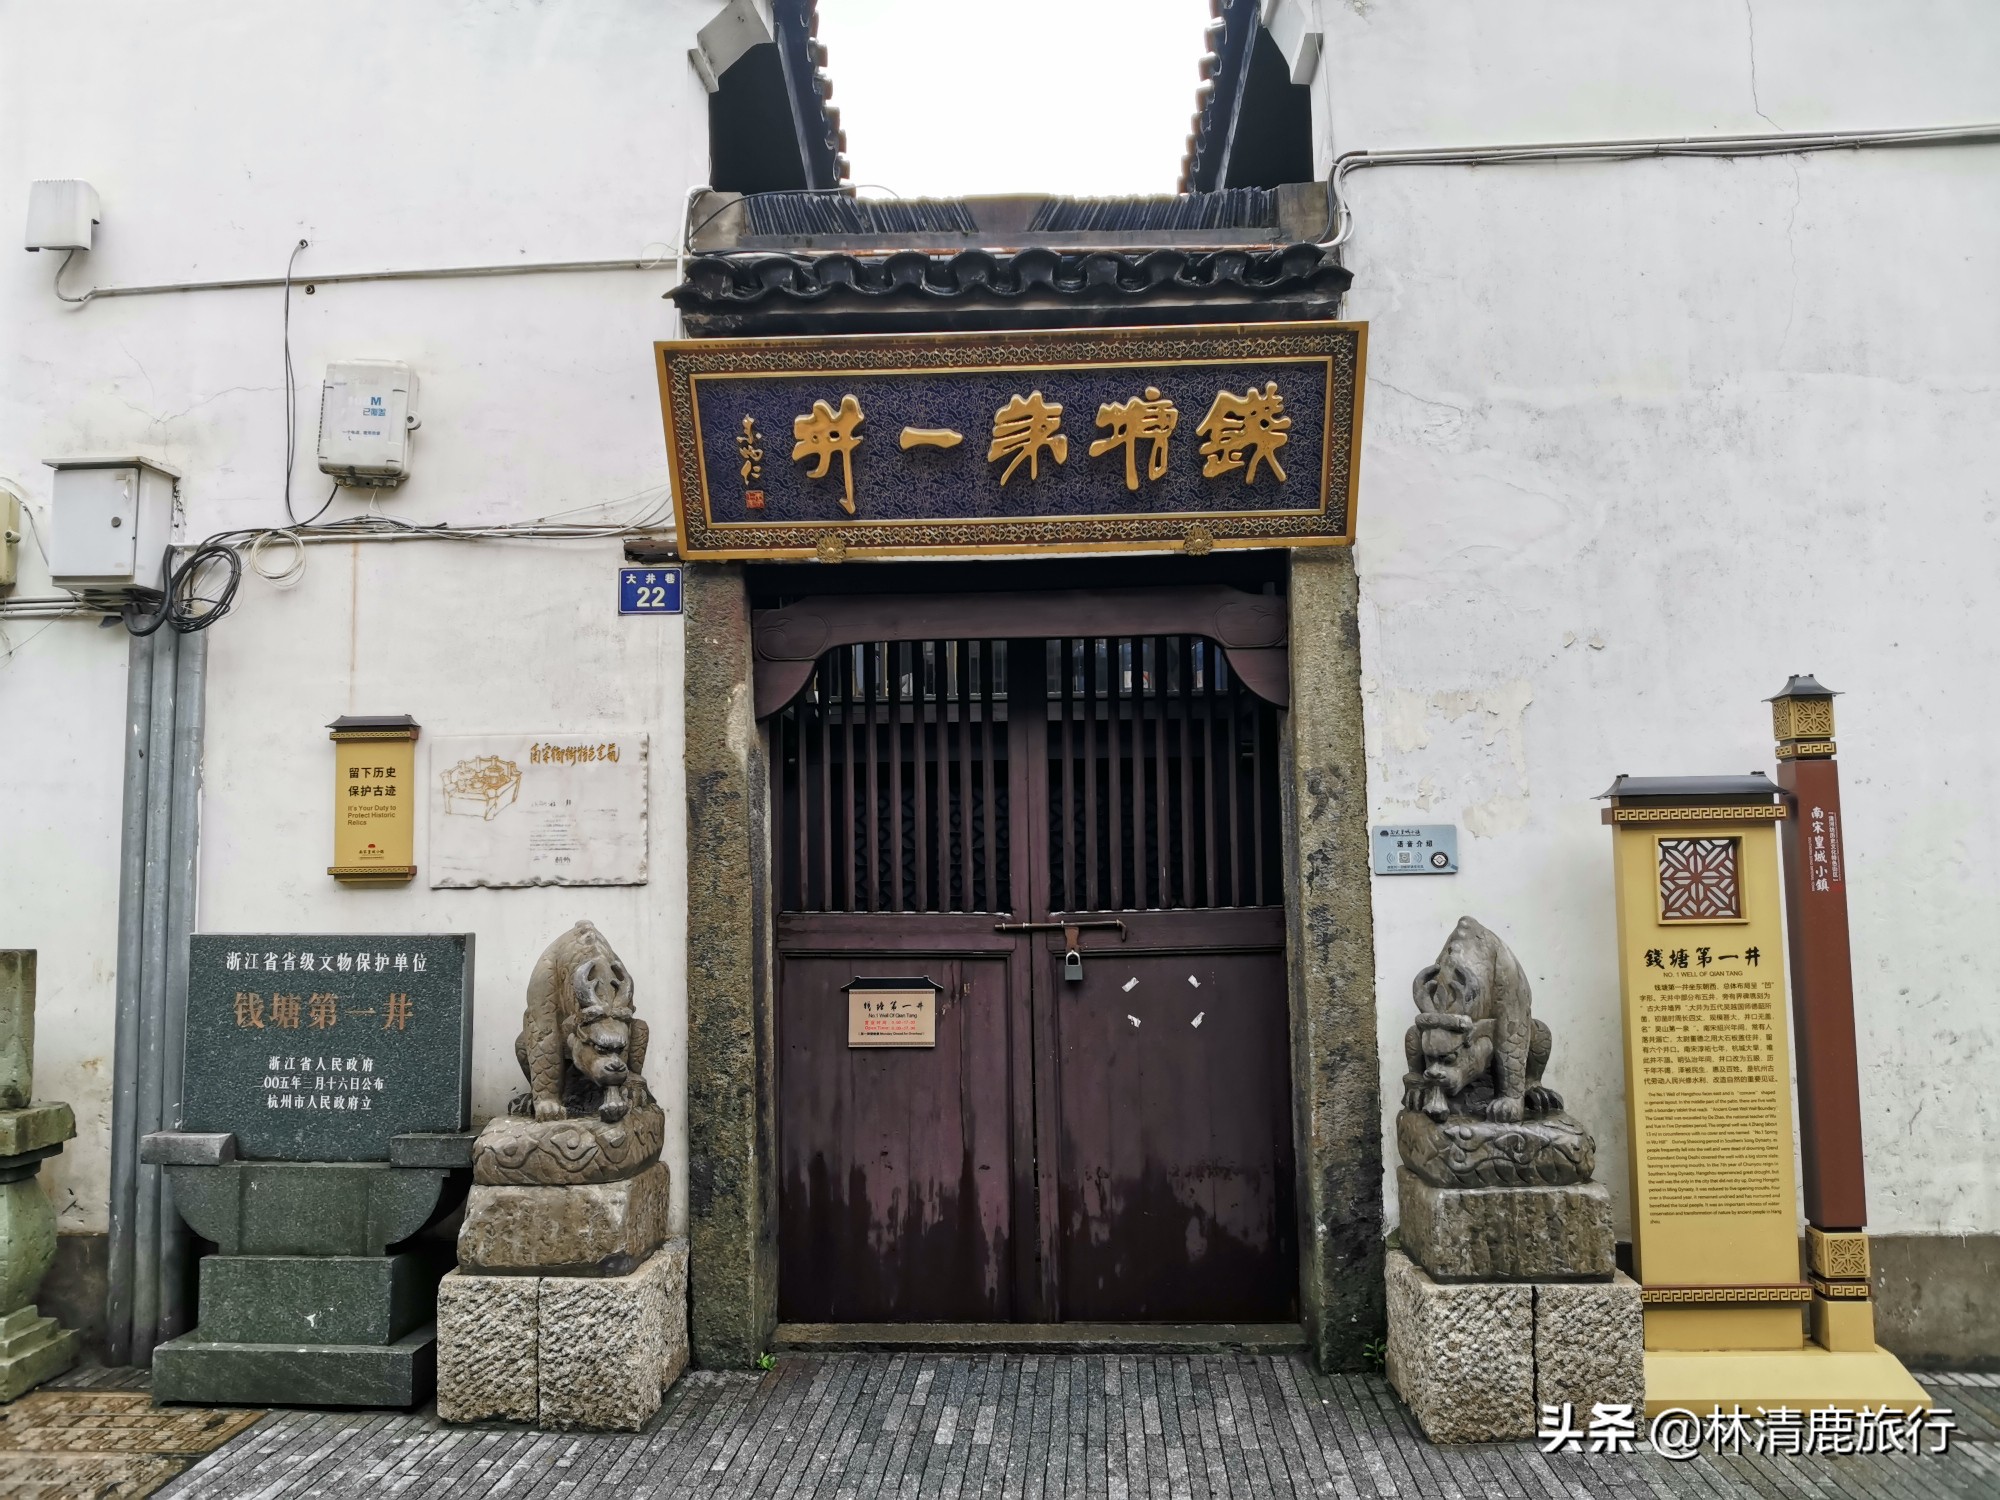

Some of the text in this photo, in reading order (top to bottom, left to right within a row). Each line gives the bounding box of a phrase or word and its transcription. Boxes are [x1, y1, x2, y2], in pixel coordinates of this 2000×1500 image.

[625, 573, 676, 585] 大井巷
[636, 586, 666, 608] 22
[348, 766, 397, 779] 留下历史
[347, 785, 397, 797] 保护古迹
[347, 804, 358, 812] It's
[358, 804, 374, 812] Your
[374, 804, 389, 813] Duty
[371, 811, 396, 819] Historic
[1396, 840, 1433, 848] 语音介绍
[226, 951, 428, 972] 浙江省省级文物保护单位
[233, 992, 414, 1031] 钱塘第一井
[268, 1056, 374, 1072] 浙江省人民政府
[267, 1094, 372, 1111] 杭州市人民政府立
